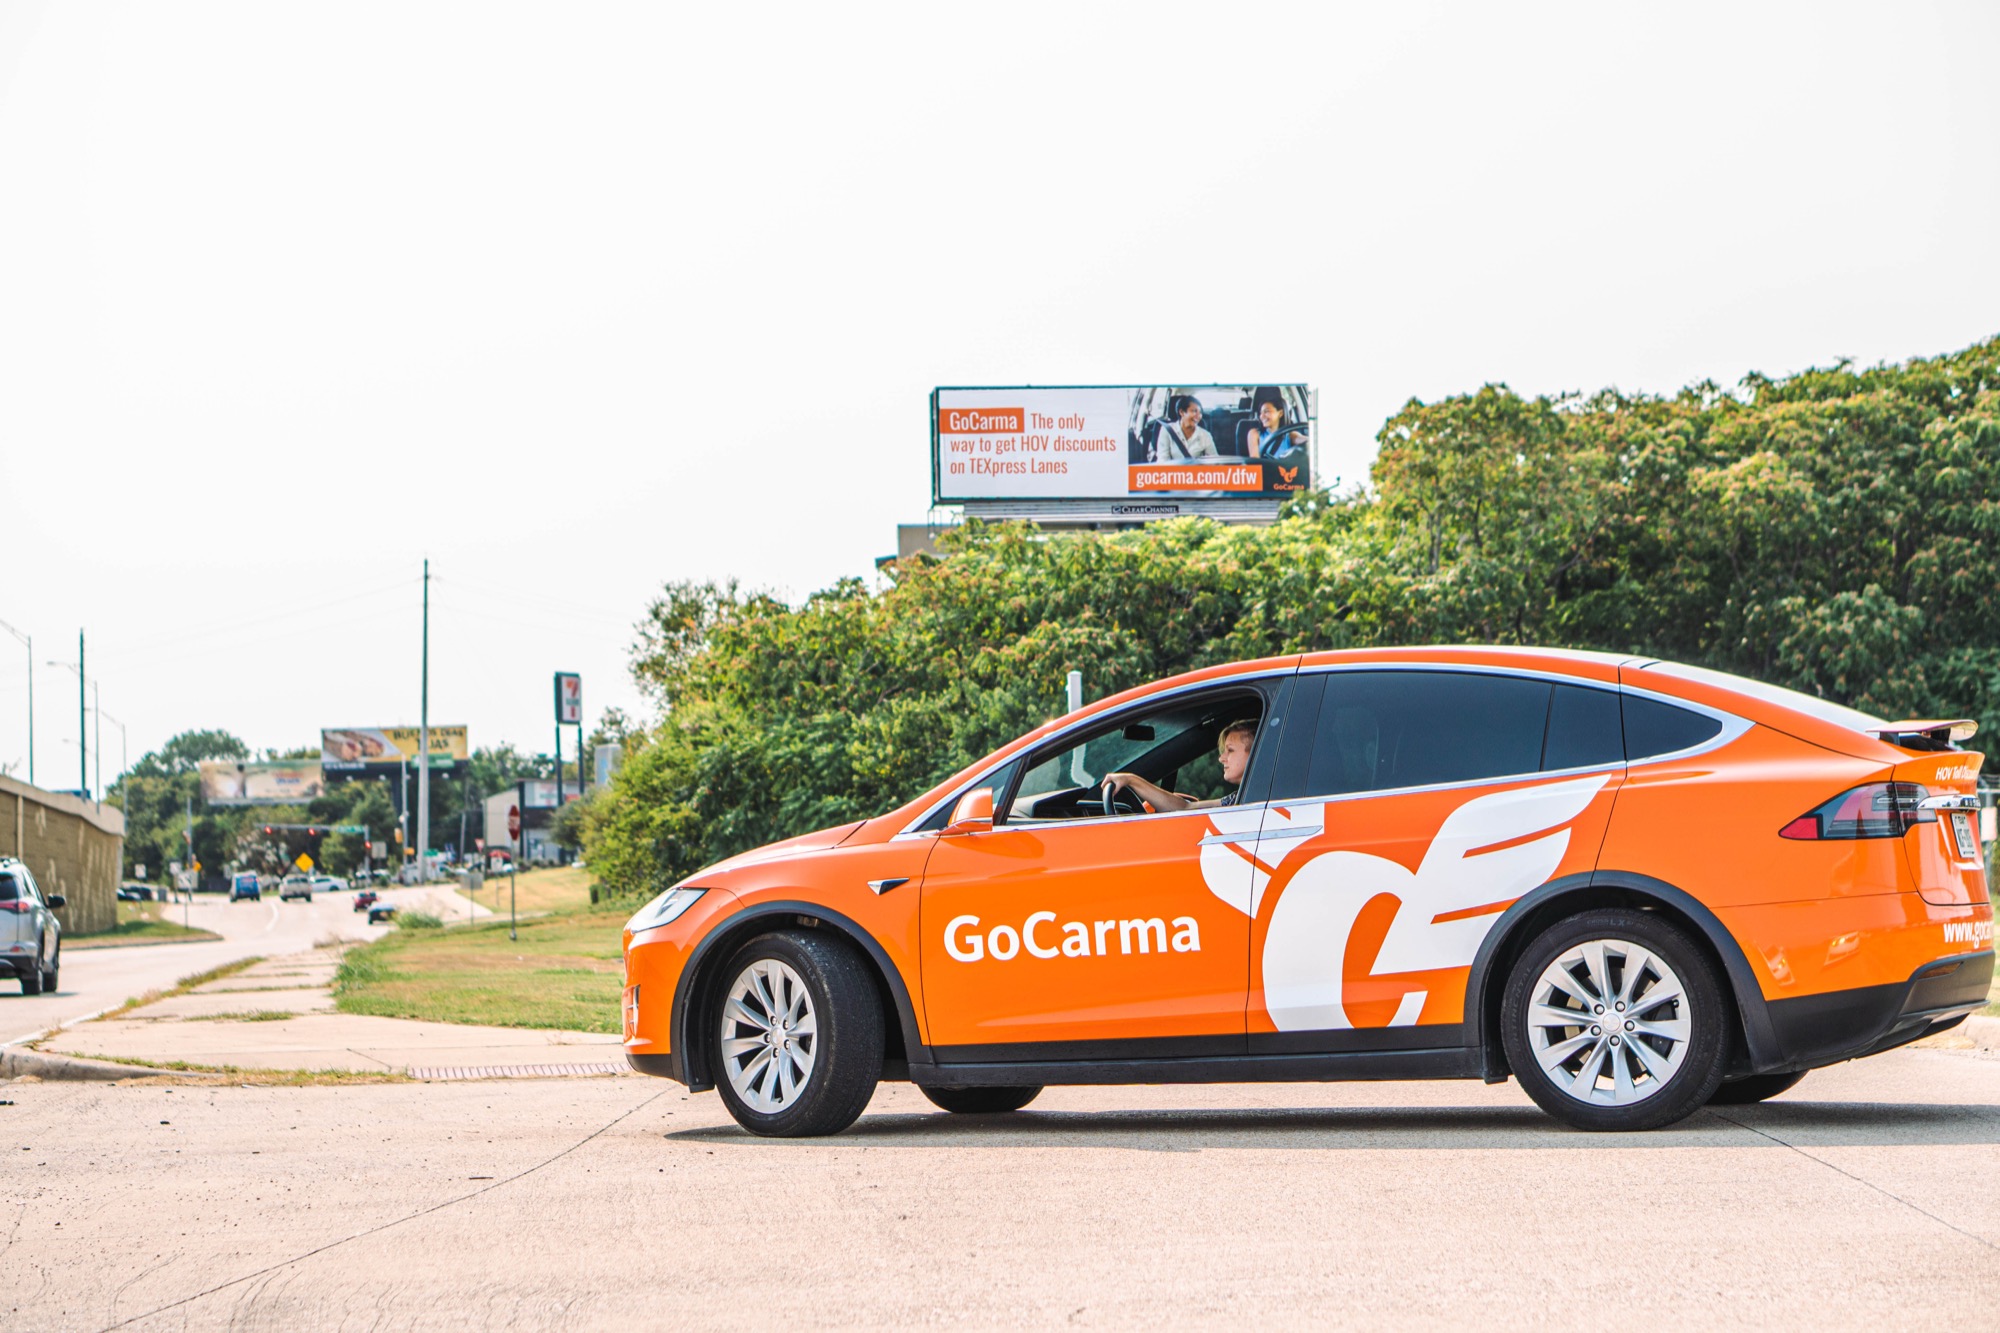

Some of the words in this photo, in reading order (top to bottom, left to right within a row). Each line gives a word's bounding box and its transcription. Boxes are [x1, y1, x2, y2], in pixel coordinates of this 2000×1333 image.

[950, 411, 1018, 431] GoCarma
[1031, 413, 1054, 429] The
[1058, 413, 1085, 432] only
[950, 440, 975, 455] way
[979, 437, 991, 452] to
[995, 437, 1016, 455] get
[1021, 435, 1049, 451] HOV
[1054, 436, 1116, 451] discounts
[950, 462, 965, 474] on
[969, 458, 1026, 477] TEXpress
[1031, 457, 1068, 474] Lanes
[1136, 468, 1257, 488] gocarma.com/dfw
[1935, 767, 1953, 781] HOV
[944, 911, 1200, 962] GoCarma
